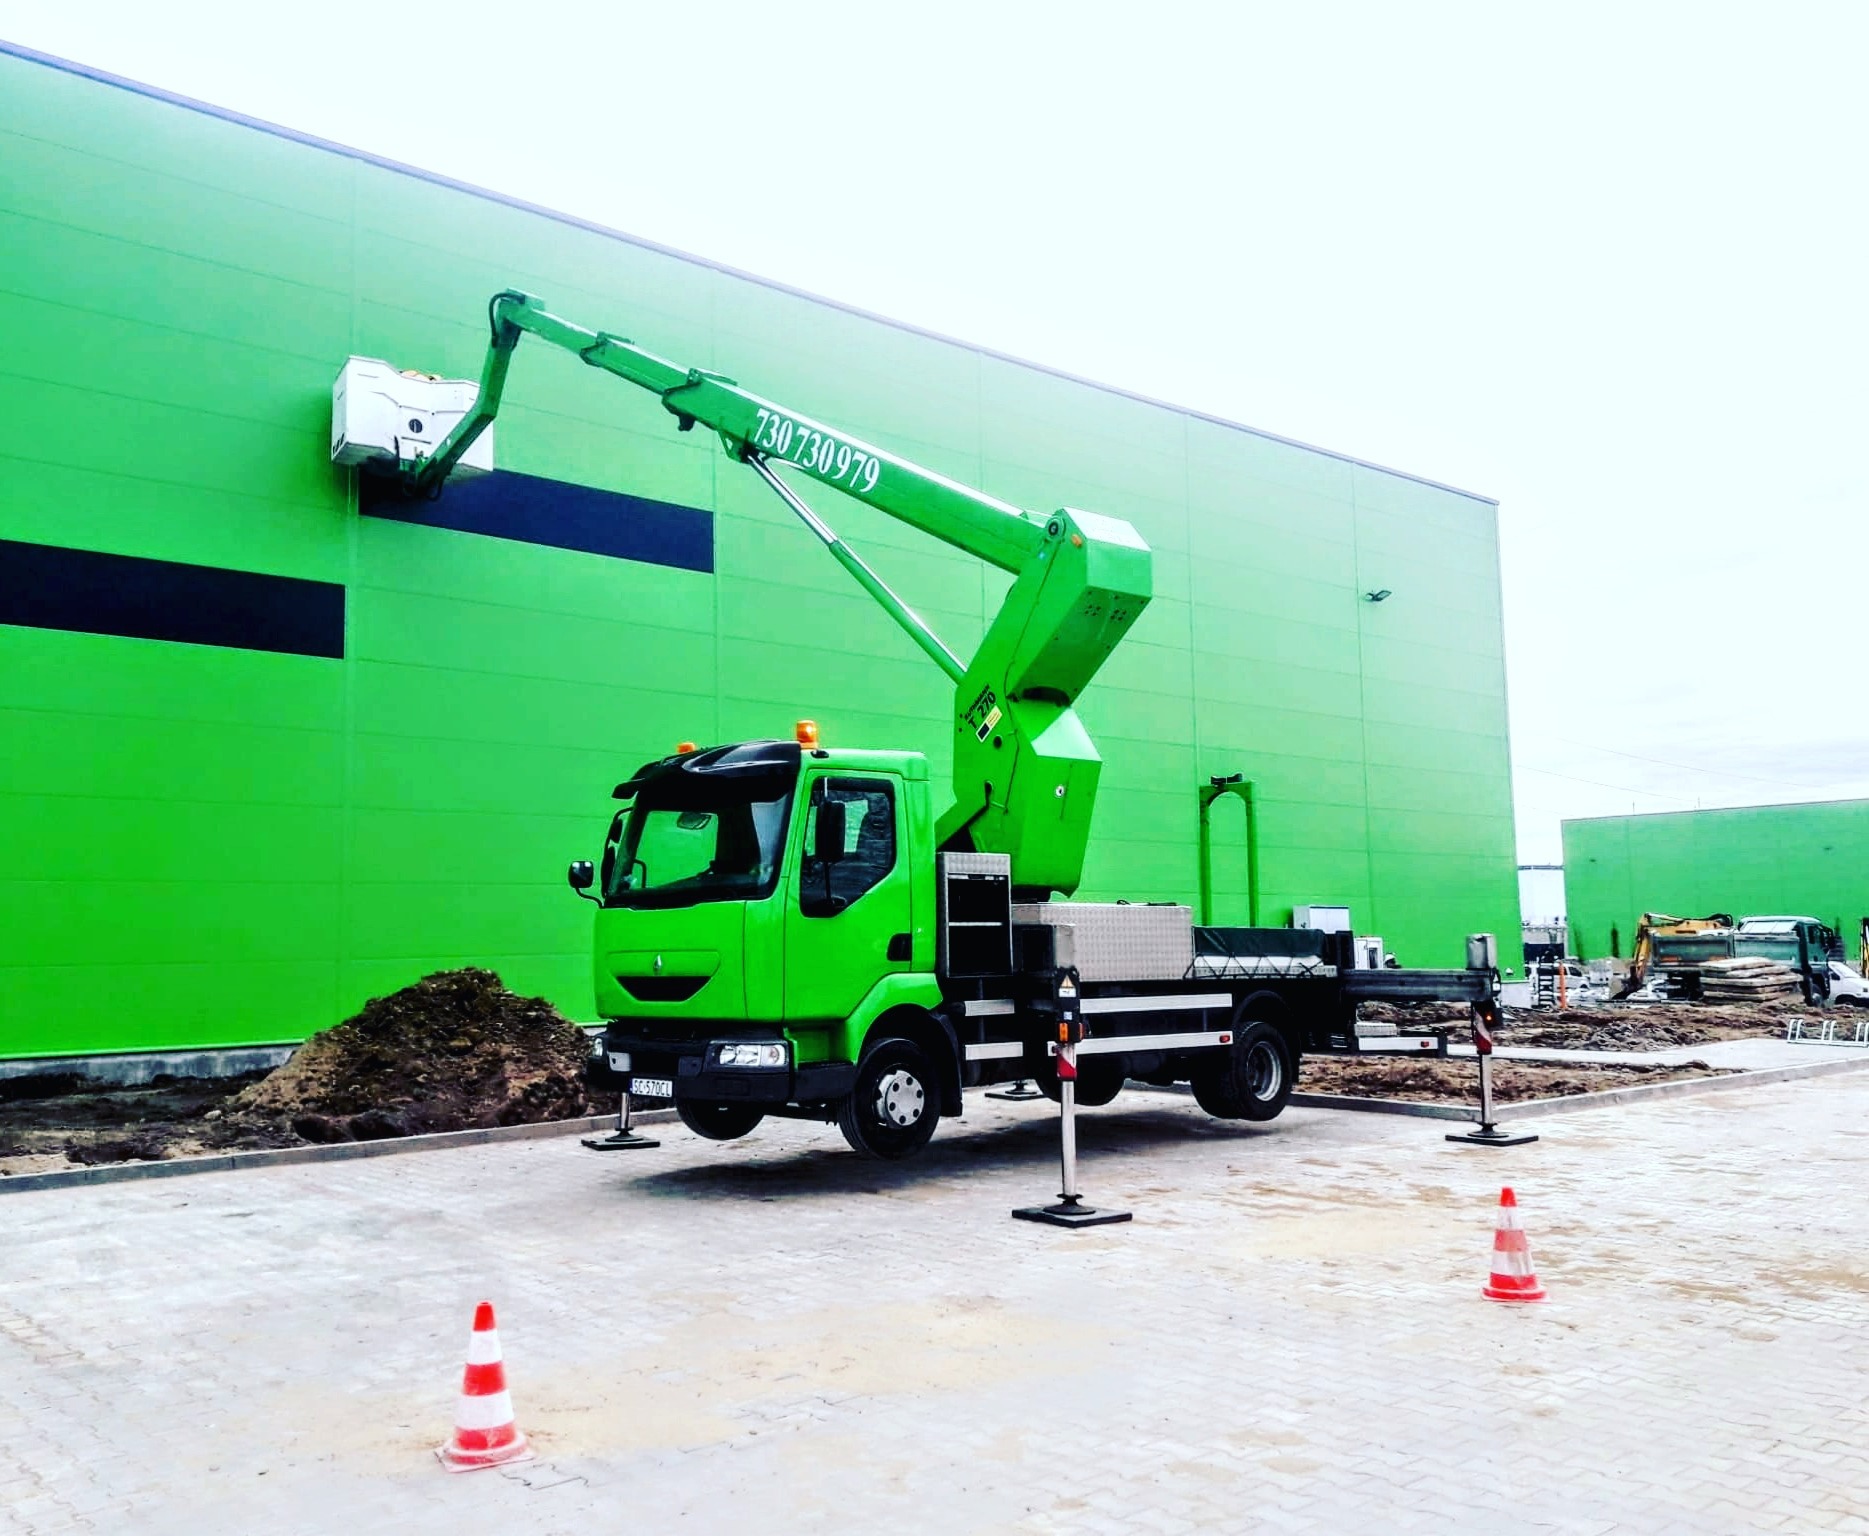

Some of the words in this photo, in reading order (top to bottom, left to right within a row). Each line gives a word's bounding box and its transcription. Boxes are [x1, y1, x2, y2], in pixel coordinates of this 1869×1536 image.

[755, 408, 792, 454] 730
[794, 426, 835, 474] 730
[831, 446, 880, 492] 979
[968, 715, 978, 729] T
[977, 691, 996, 718] 270
[634, 1080, 643, 1094] SC
